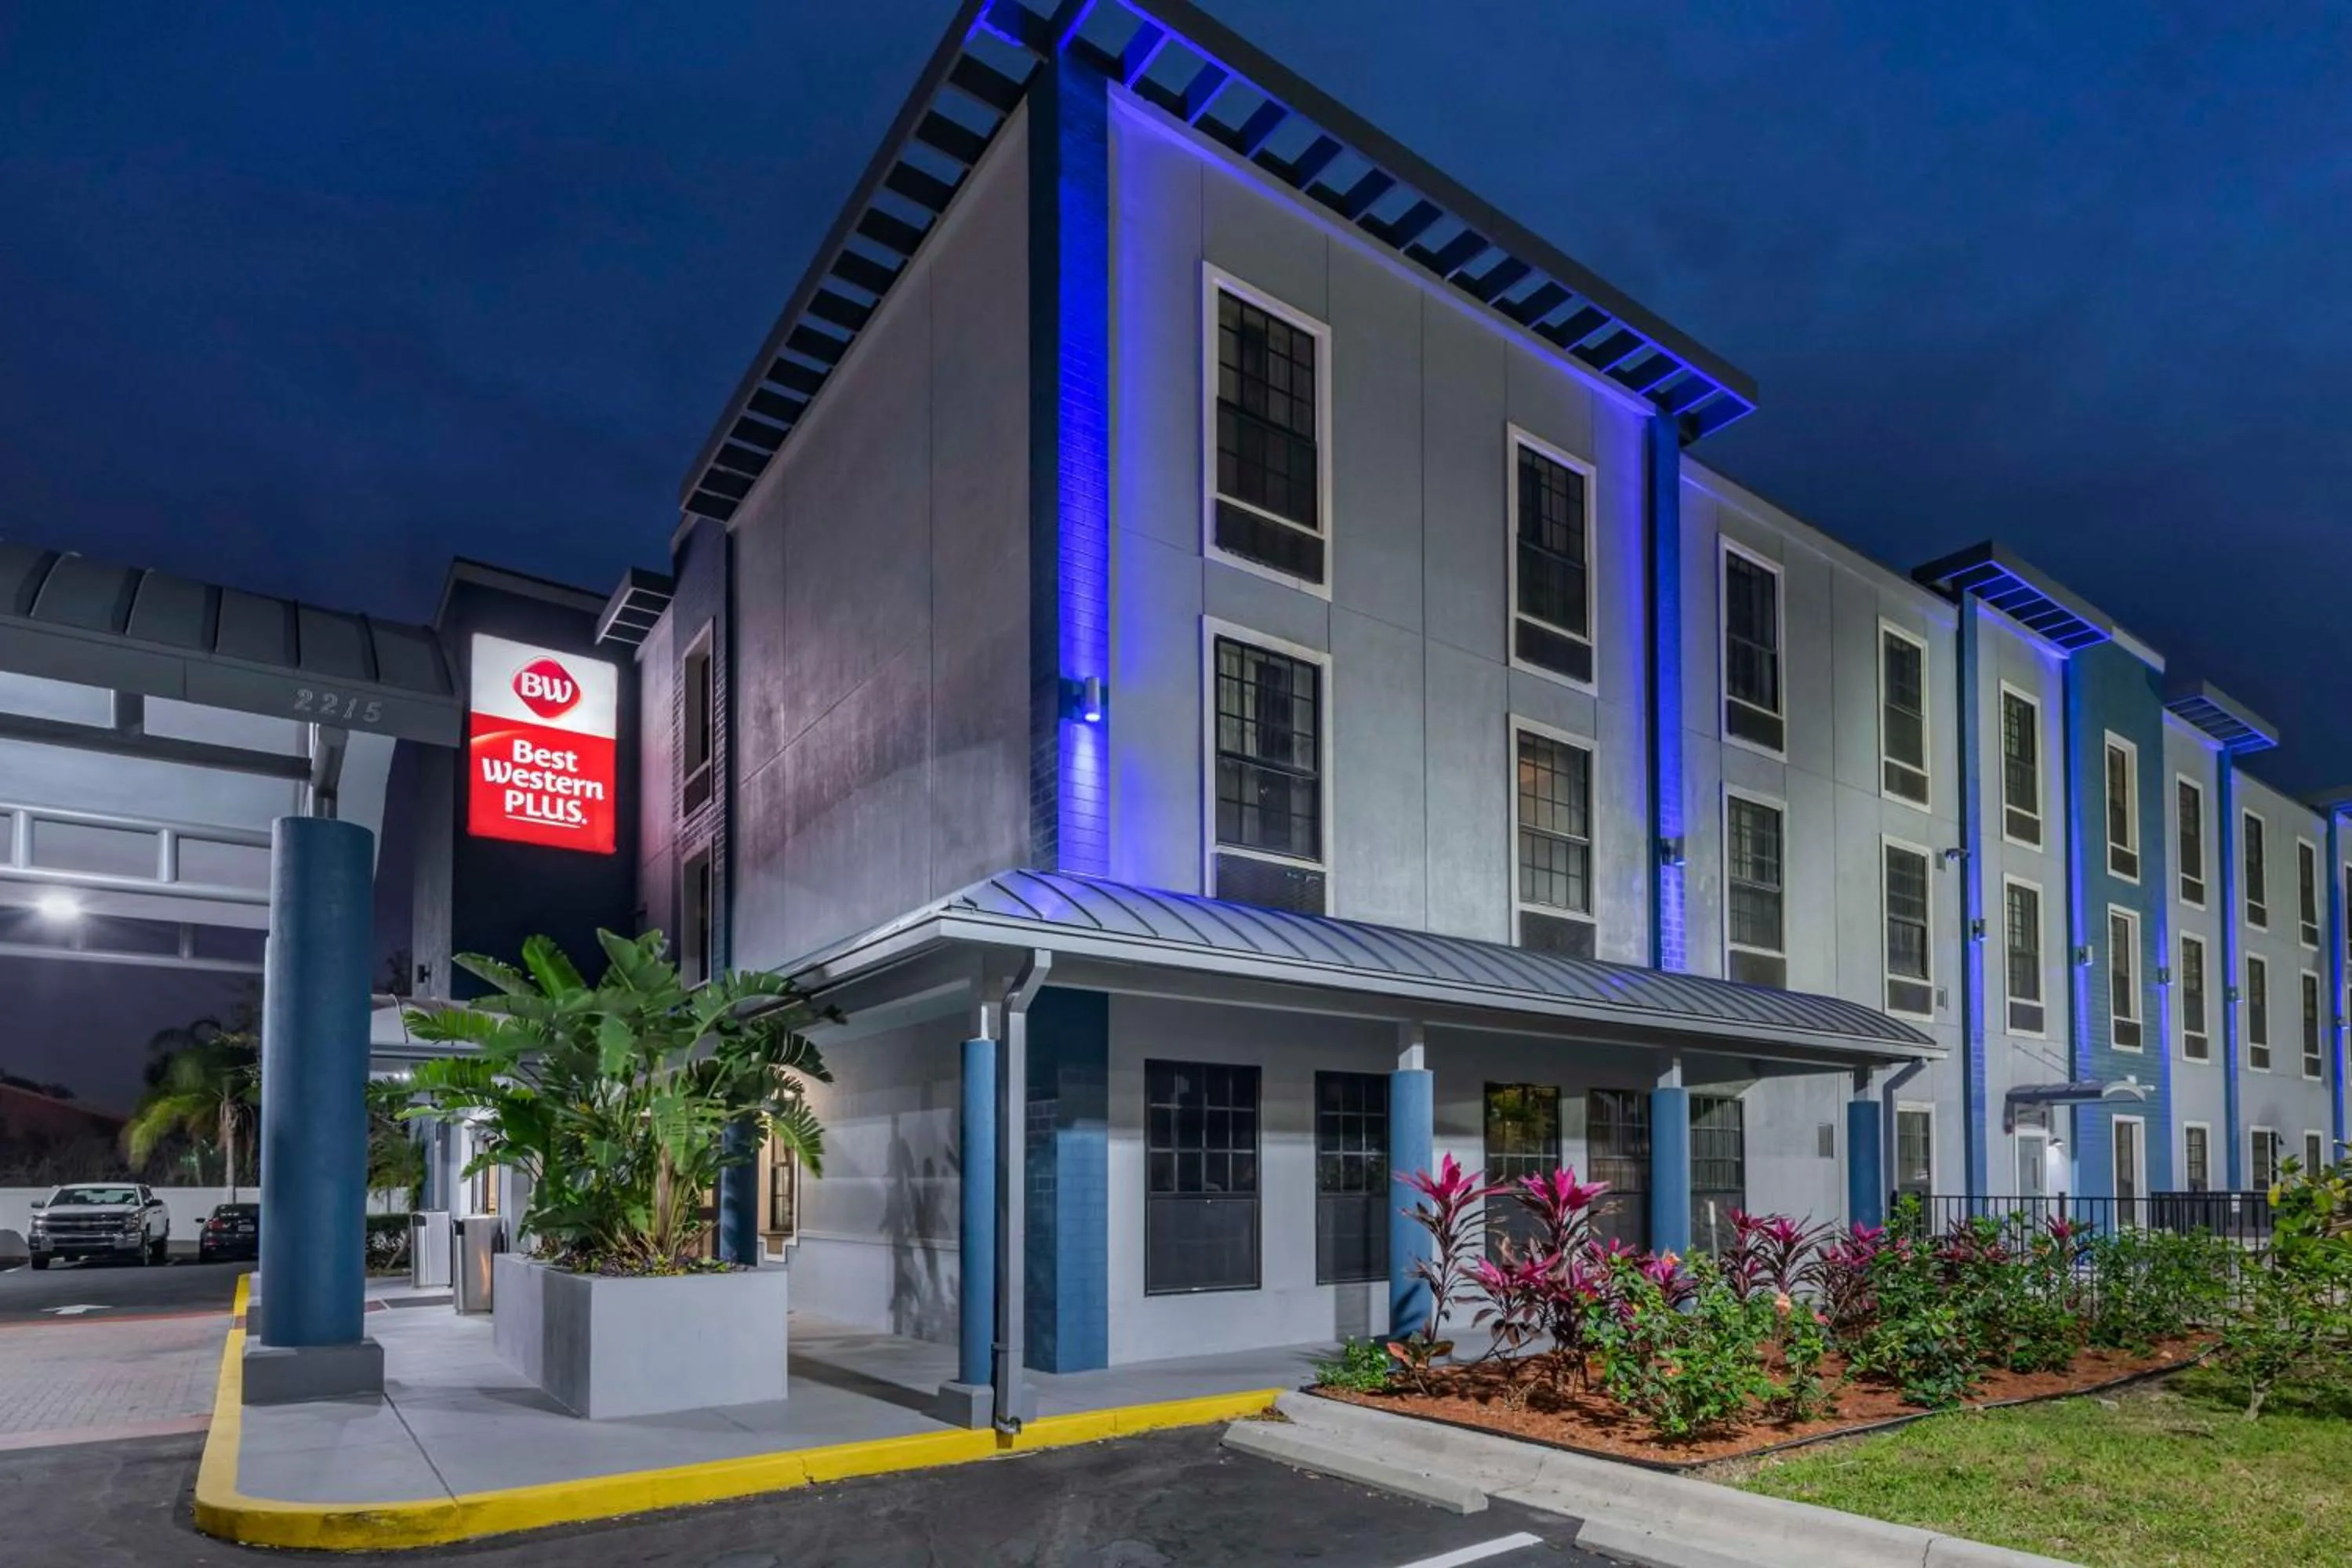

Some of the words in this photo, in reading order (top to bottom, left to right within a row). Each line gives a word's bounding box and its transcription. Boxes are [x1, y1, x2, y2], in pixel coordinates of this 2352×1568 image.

[521, 672, 572, 703] BW
[294, 689, 382, 722] 2215
[513, 739, 578, 772] Best
[482, 757, 604, 800] Western
